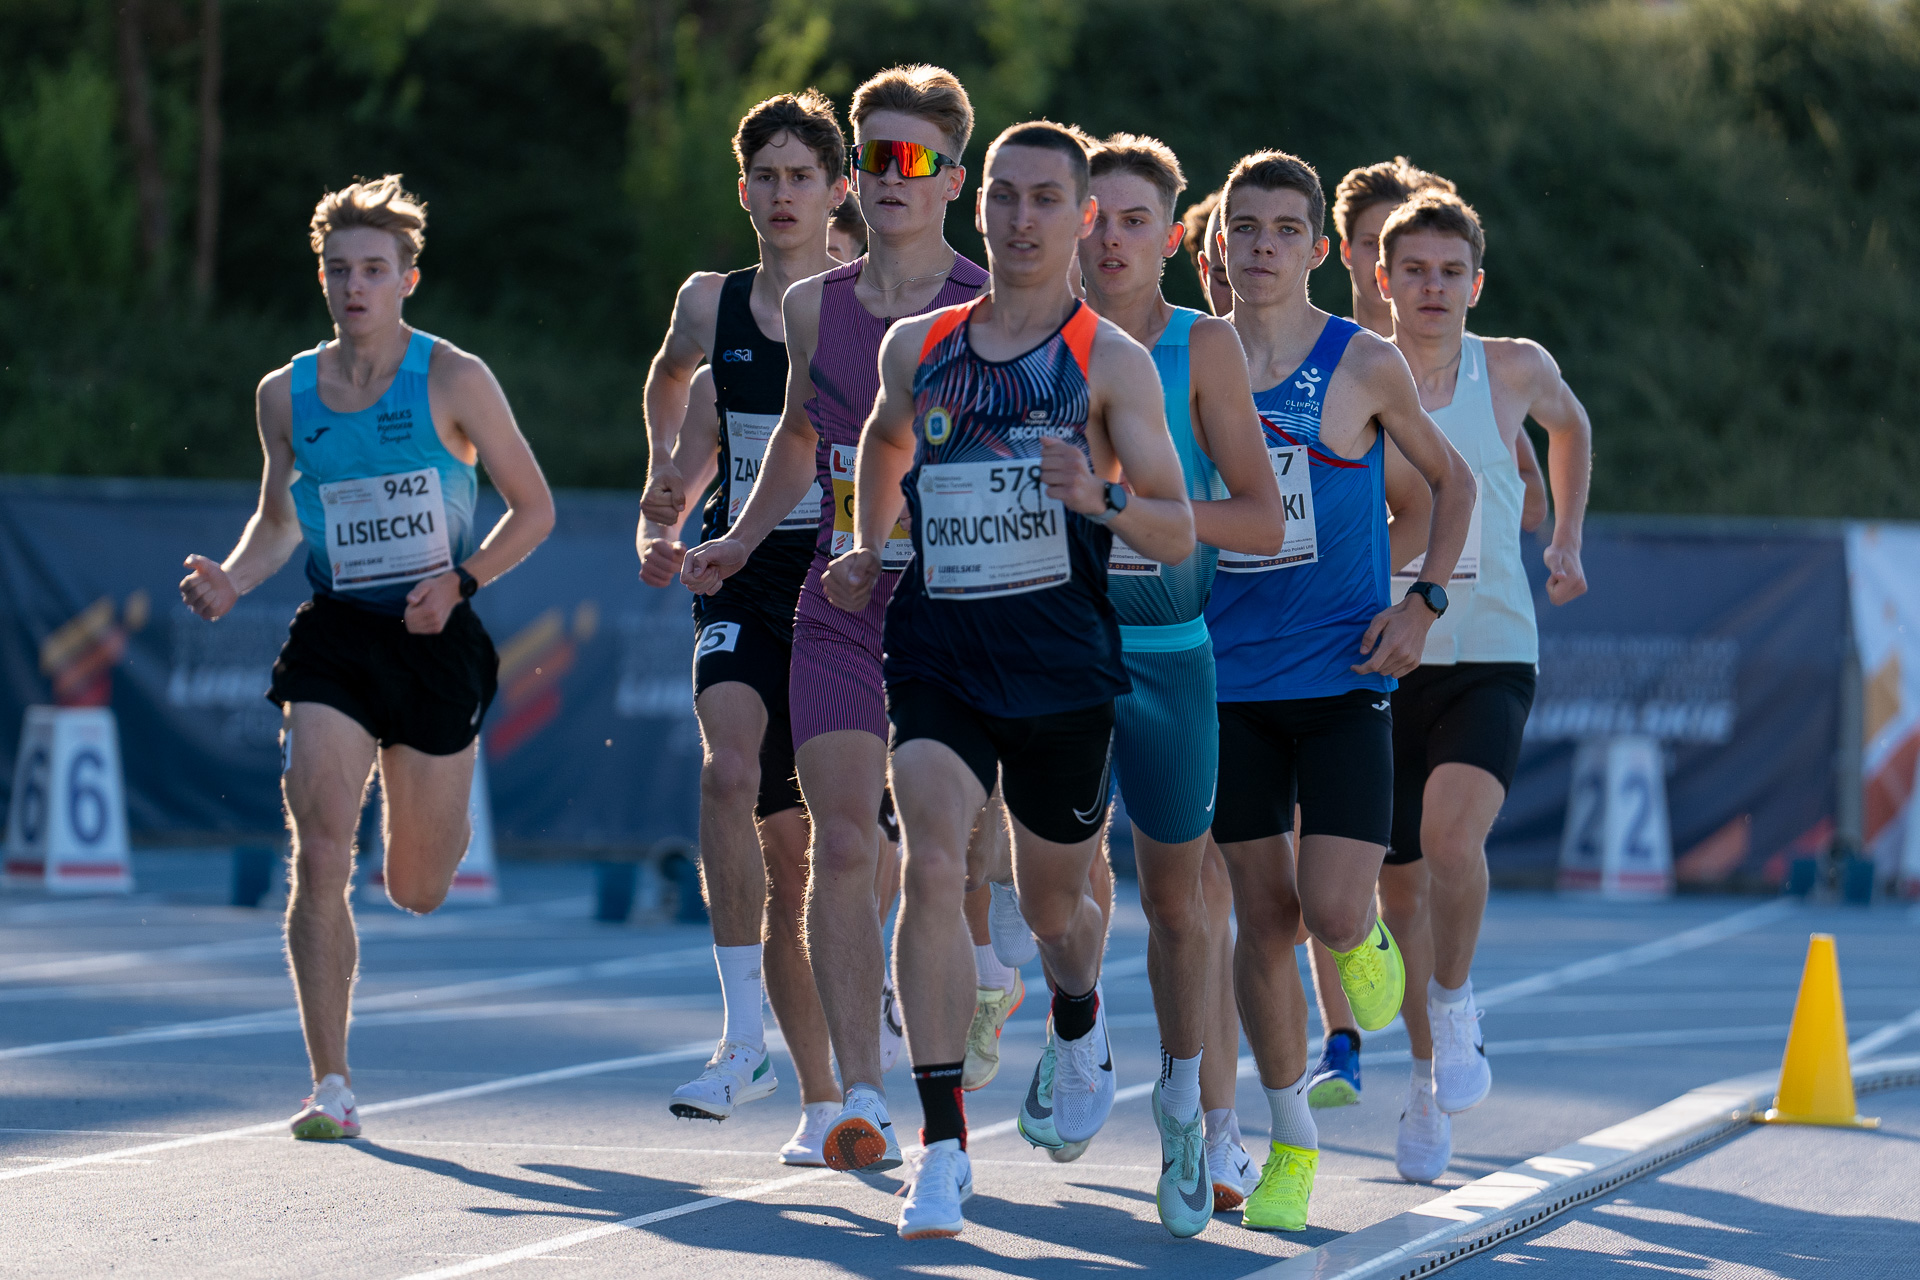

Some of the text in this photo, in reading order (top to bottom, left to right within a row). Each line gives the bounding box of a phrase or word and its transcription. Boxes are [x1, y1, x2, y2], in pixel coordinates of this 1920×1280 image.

[723, 349, 752, 362] esa
[1285, 399, 1319, 412] OLIMPIA
[1009, 426, 1075, 440] DECATHLON
[384, 475, 429, 500] 942
[990, 465, 1042, 493] 579
[336, 511, 434, 546] LISIECKI
[926, 507, 1056, 546] OKRUCIŃSKI
[938, 563, 981, 574] LUBELSKIE
[702, 624, 728, 651] 5
[68, 746, 110, 847] 6
[1620, 772, 1652, 859] 2
